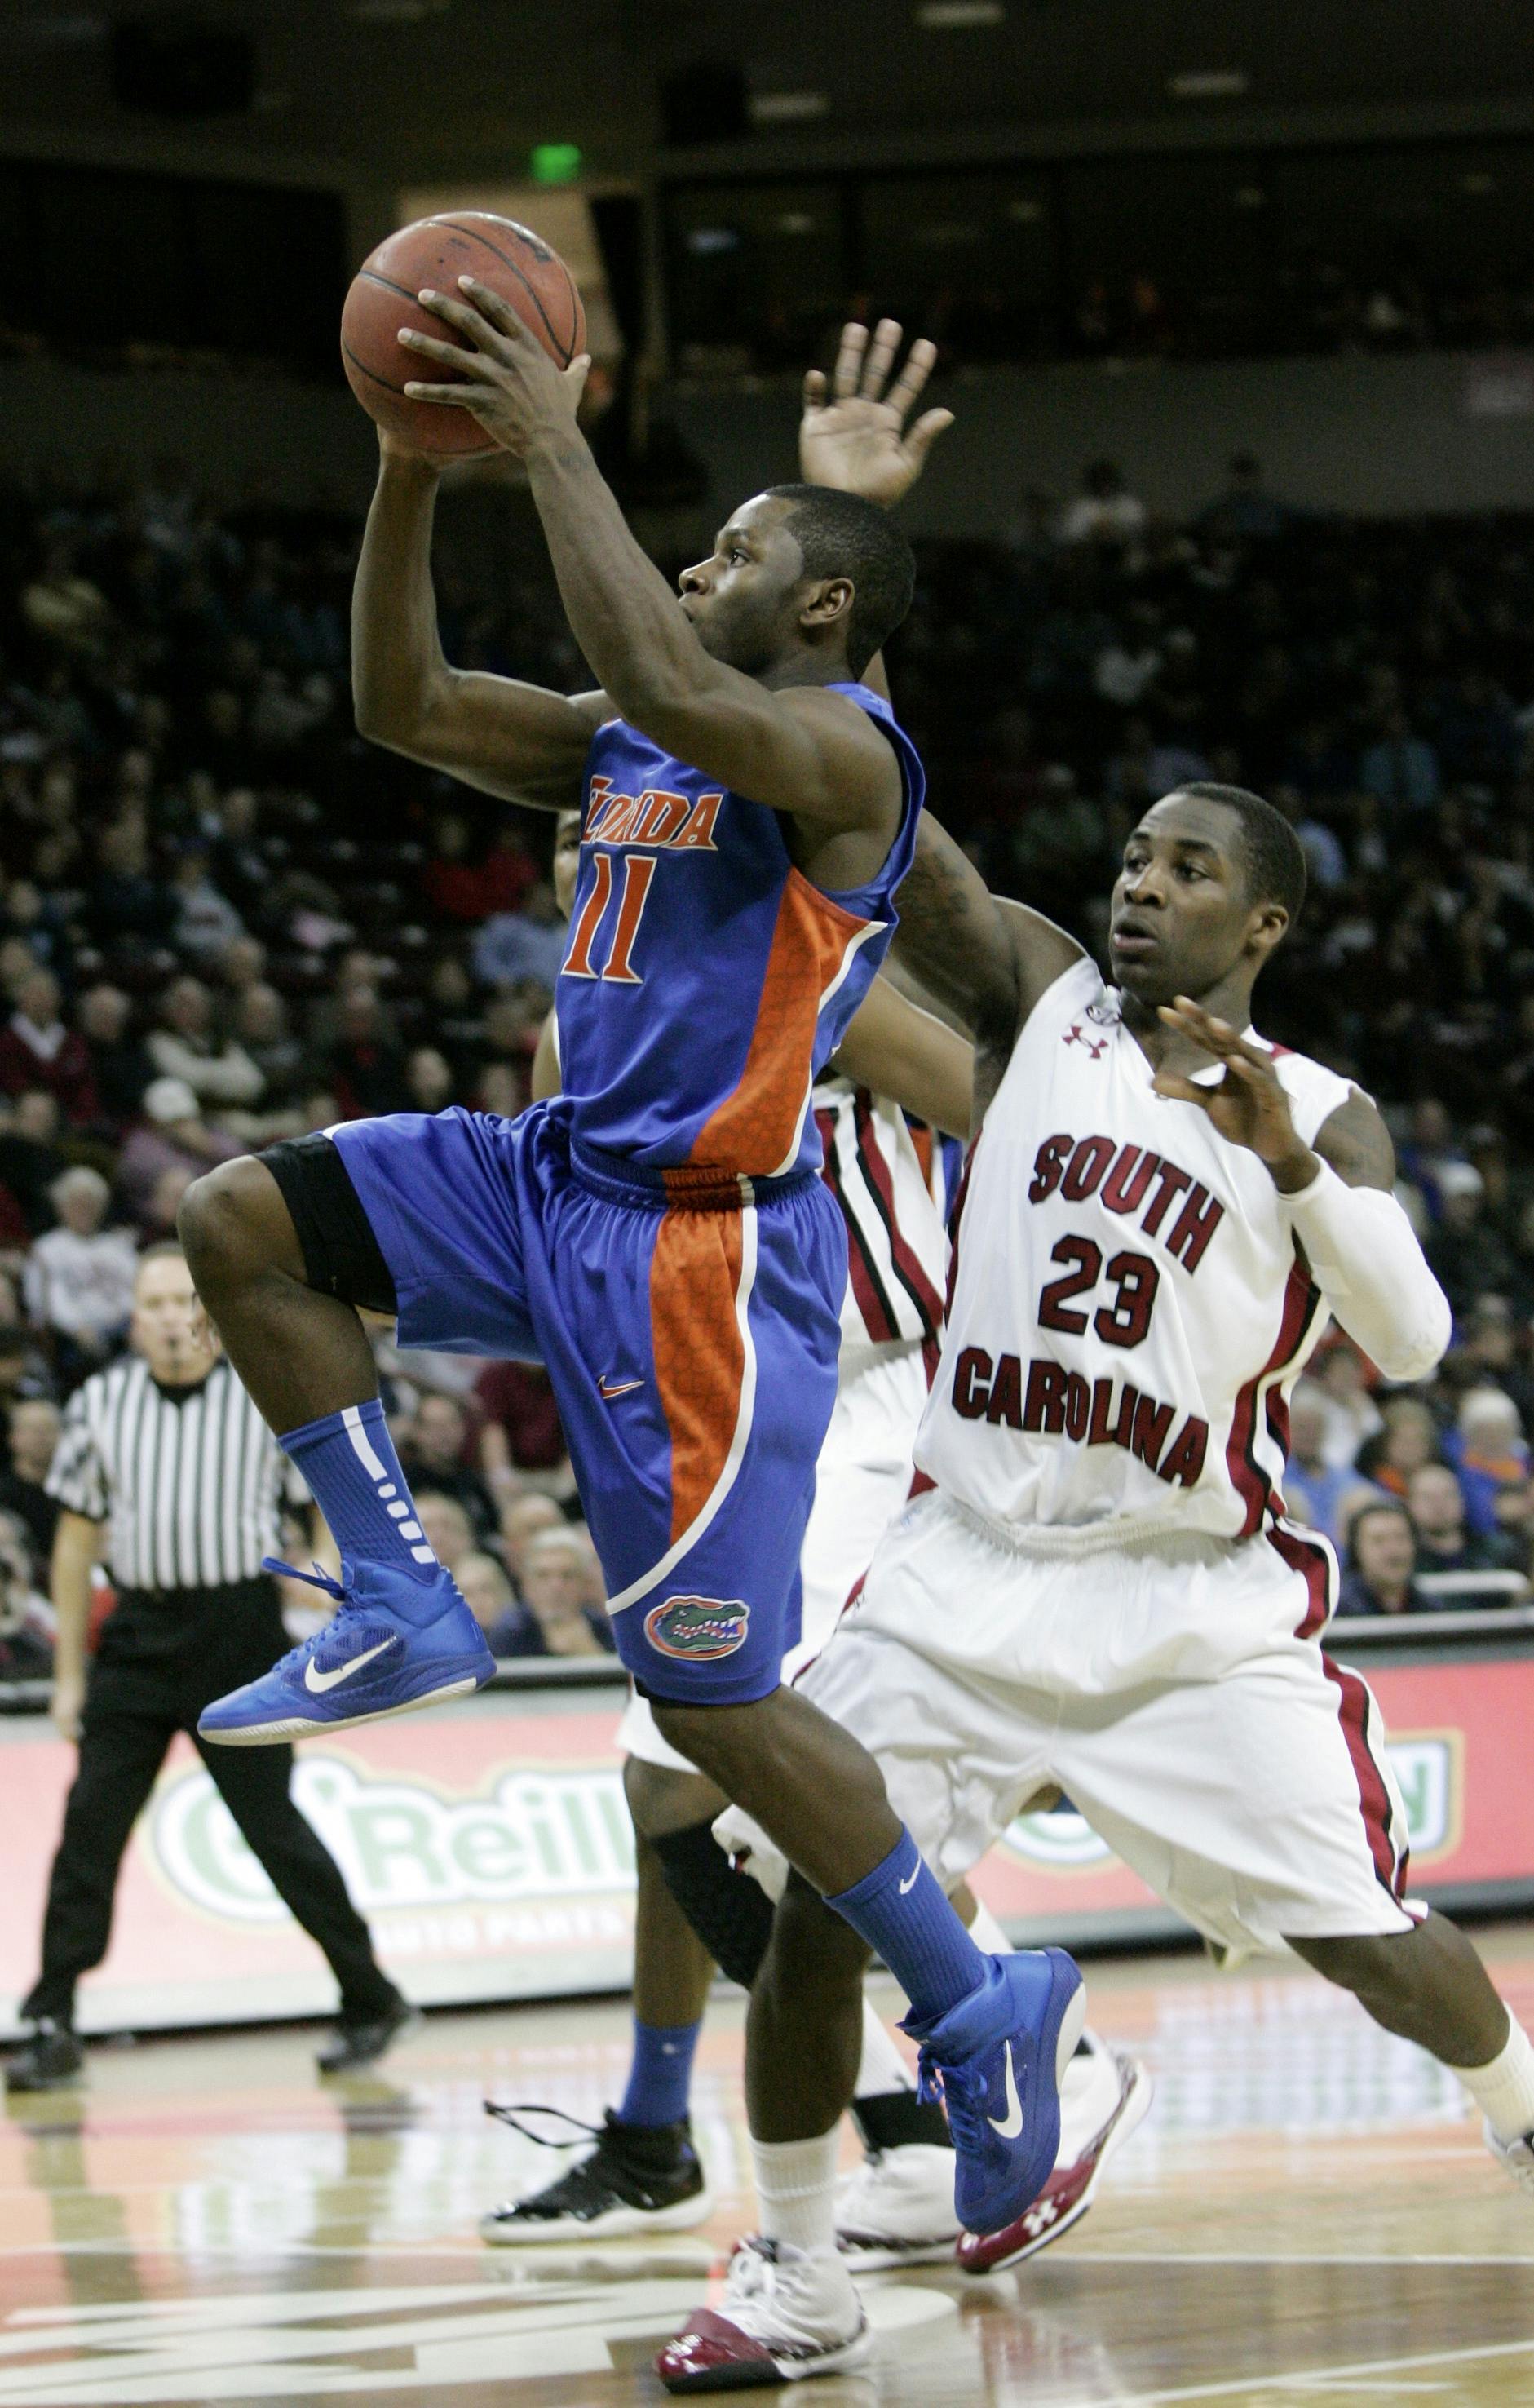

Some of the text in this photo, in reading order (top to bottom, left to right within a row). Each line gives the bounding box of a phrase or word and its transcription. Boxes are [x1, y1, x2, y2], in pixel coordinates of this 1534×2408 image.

[580, 774, 724, 852] LOIDA
[560, 852, 658, 985] 11
[1028, 1134, 1225, 1276] SOUTH
[1038, 1233, 1160, 1350] 23
[951, 1346, 1209, 1488] CAROLINA
[181, 1775, 635, 1904] O'Reill
